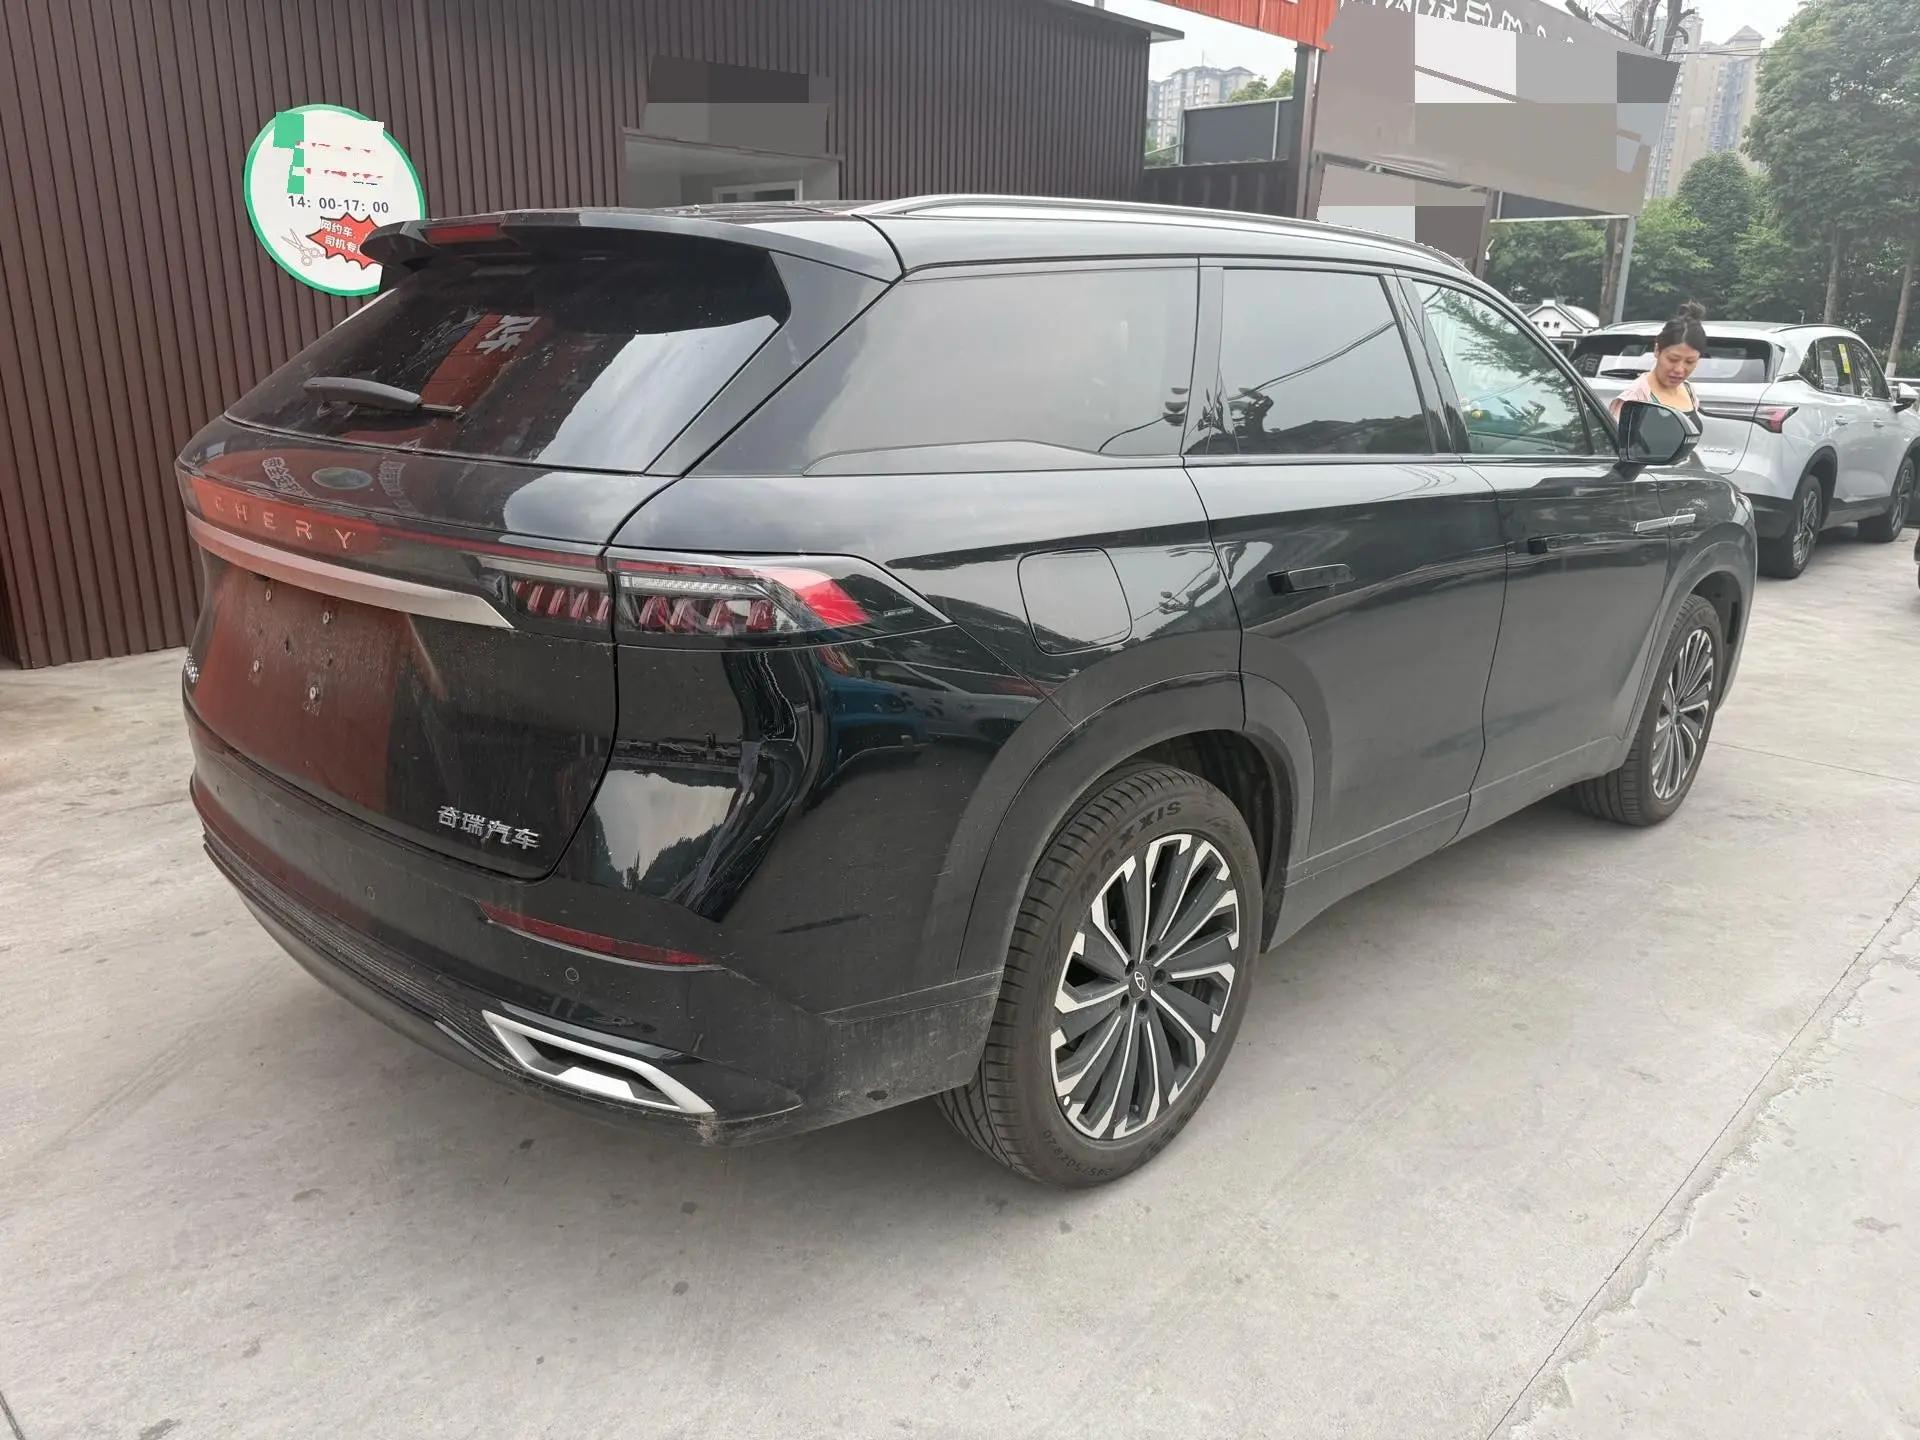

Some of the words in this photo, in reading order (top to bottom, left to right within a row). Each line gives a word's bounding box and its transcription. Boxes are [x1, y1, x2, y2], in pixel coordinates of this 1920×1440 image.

[325, 235, 361, 255] 司机专
[215, 496, 353, 549] CHERY
[437, 804, 540, 849] 奇瑞汽车
